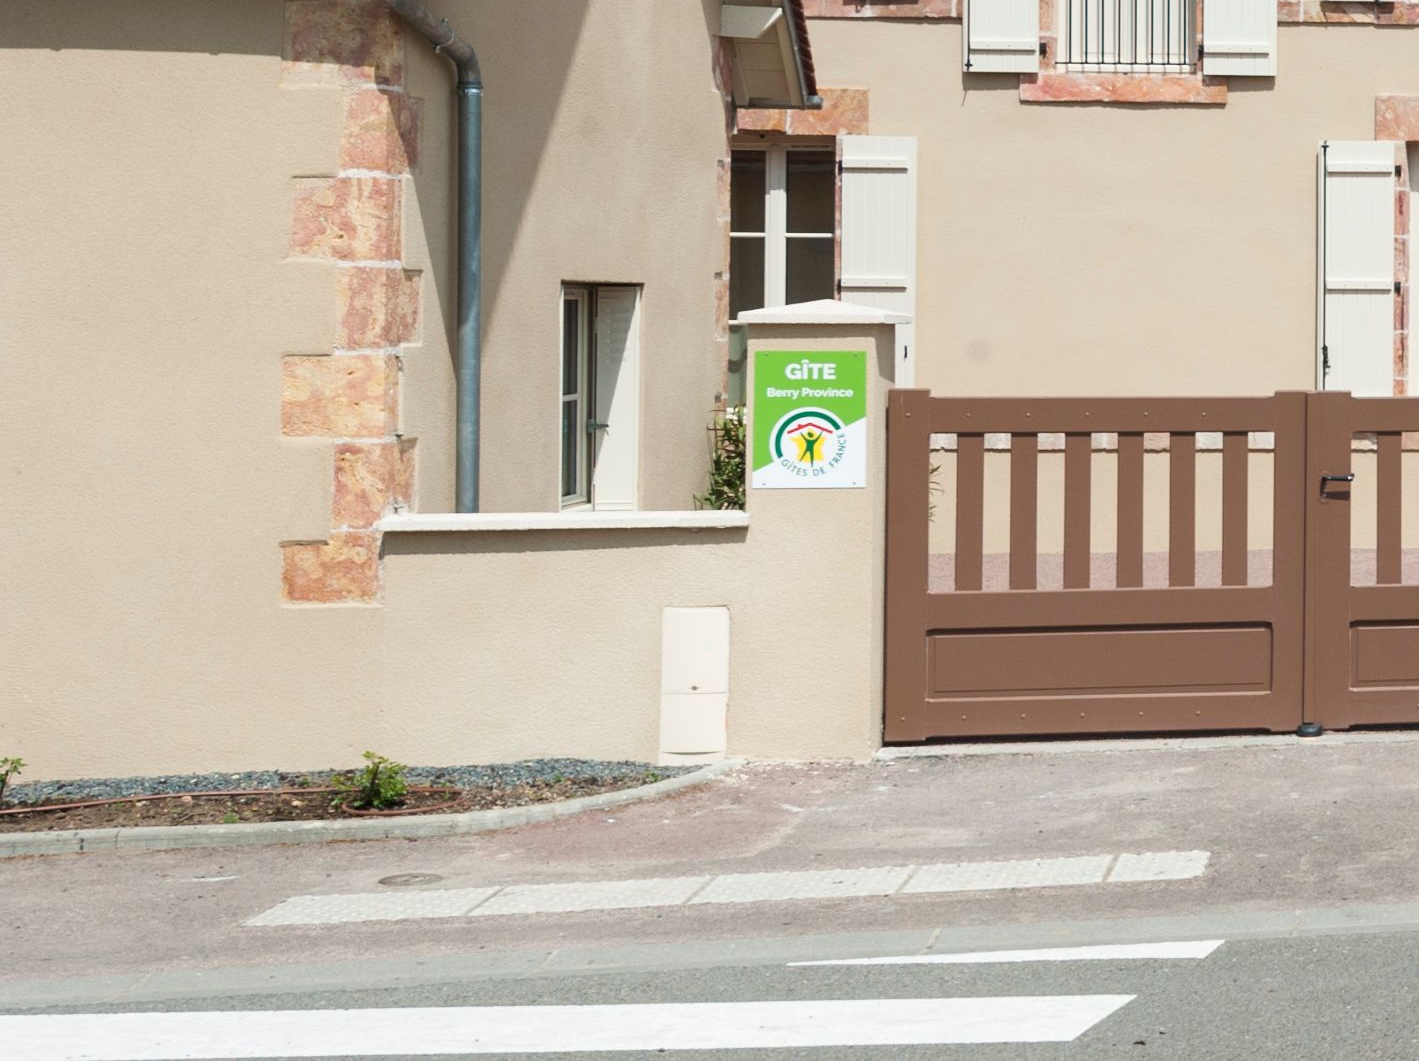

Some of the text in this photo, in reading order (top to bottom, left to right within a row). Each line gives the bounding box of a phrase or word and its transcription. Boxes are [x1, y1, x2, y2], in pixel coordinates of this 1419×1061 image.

[785, 359, 837, 380] GÎTE
[766, 387, 854, 400] Berry Province
[812, 467, 826, 477] DE
[828, 433, 847, 468] FRANCE
